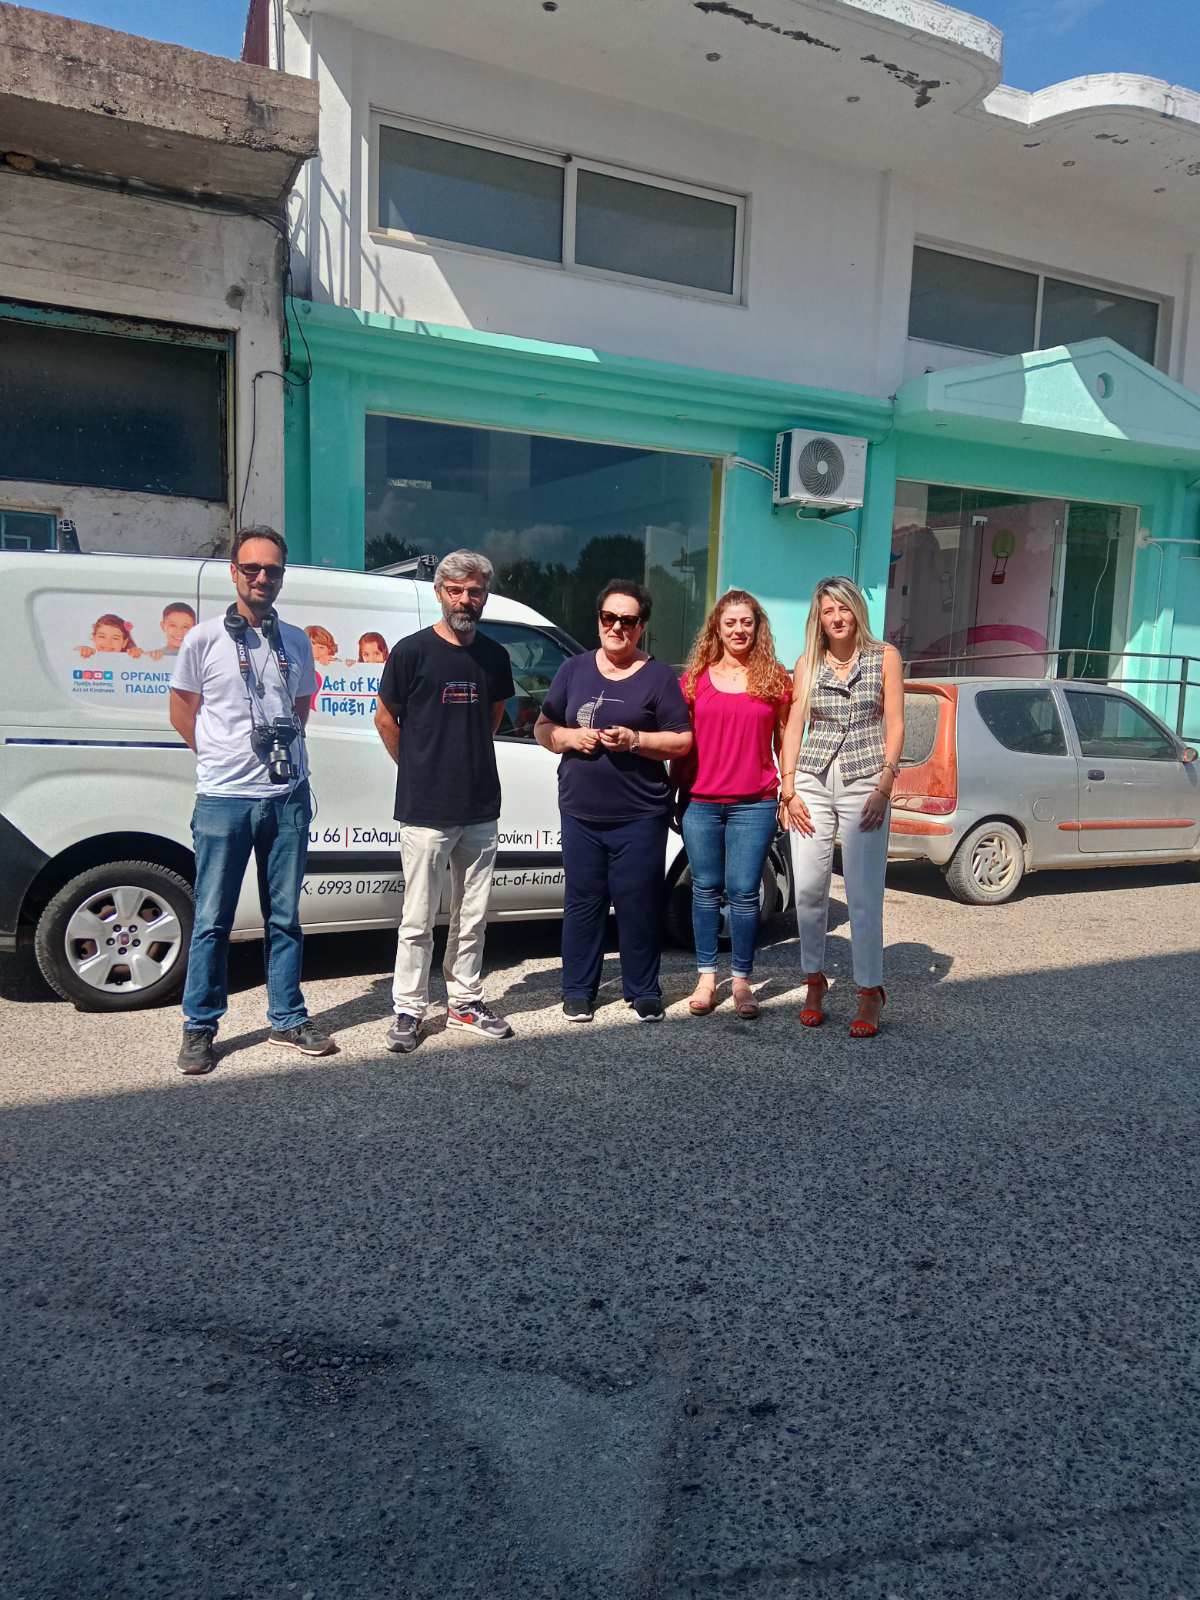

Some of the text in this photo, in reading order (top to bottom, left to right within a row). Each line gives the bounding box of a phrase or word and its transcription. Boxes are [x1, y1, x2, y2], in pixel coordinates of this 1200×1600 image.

[322, 676, 346, 691] Act
[350, 677, 364, 692] of
[321, 697, 365, 716] Πράξη
[323, 828, 341, 843] 66
[317, 880, 352, 895] 6993
